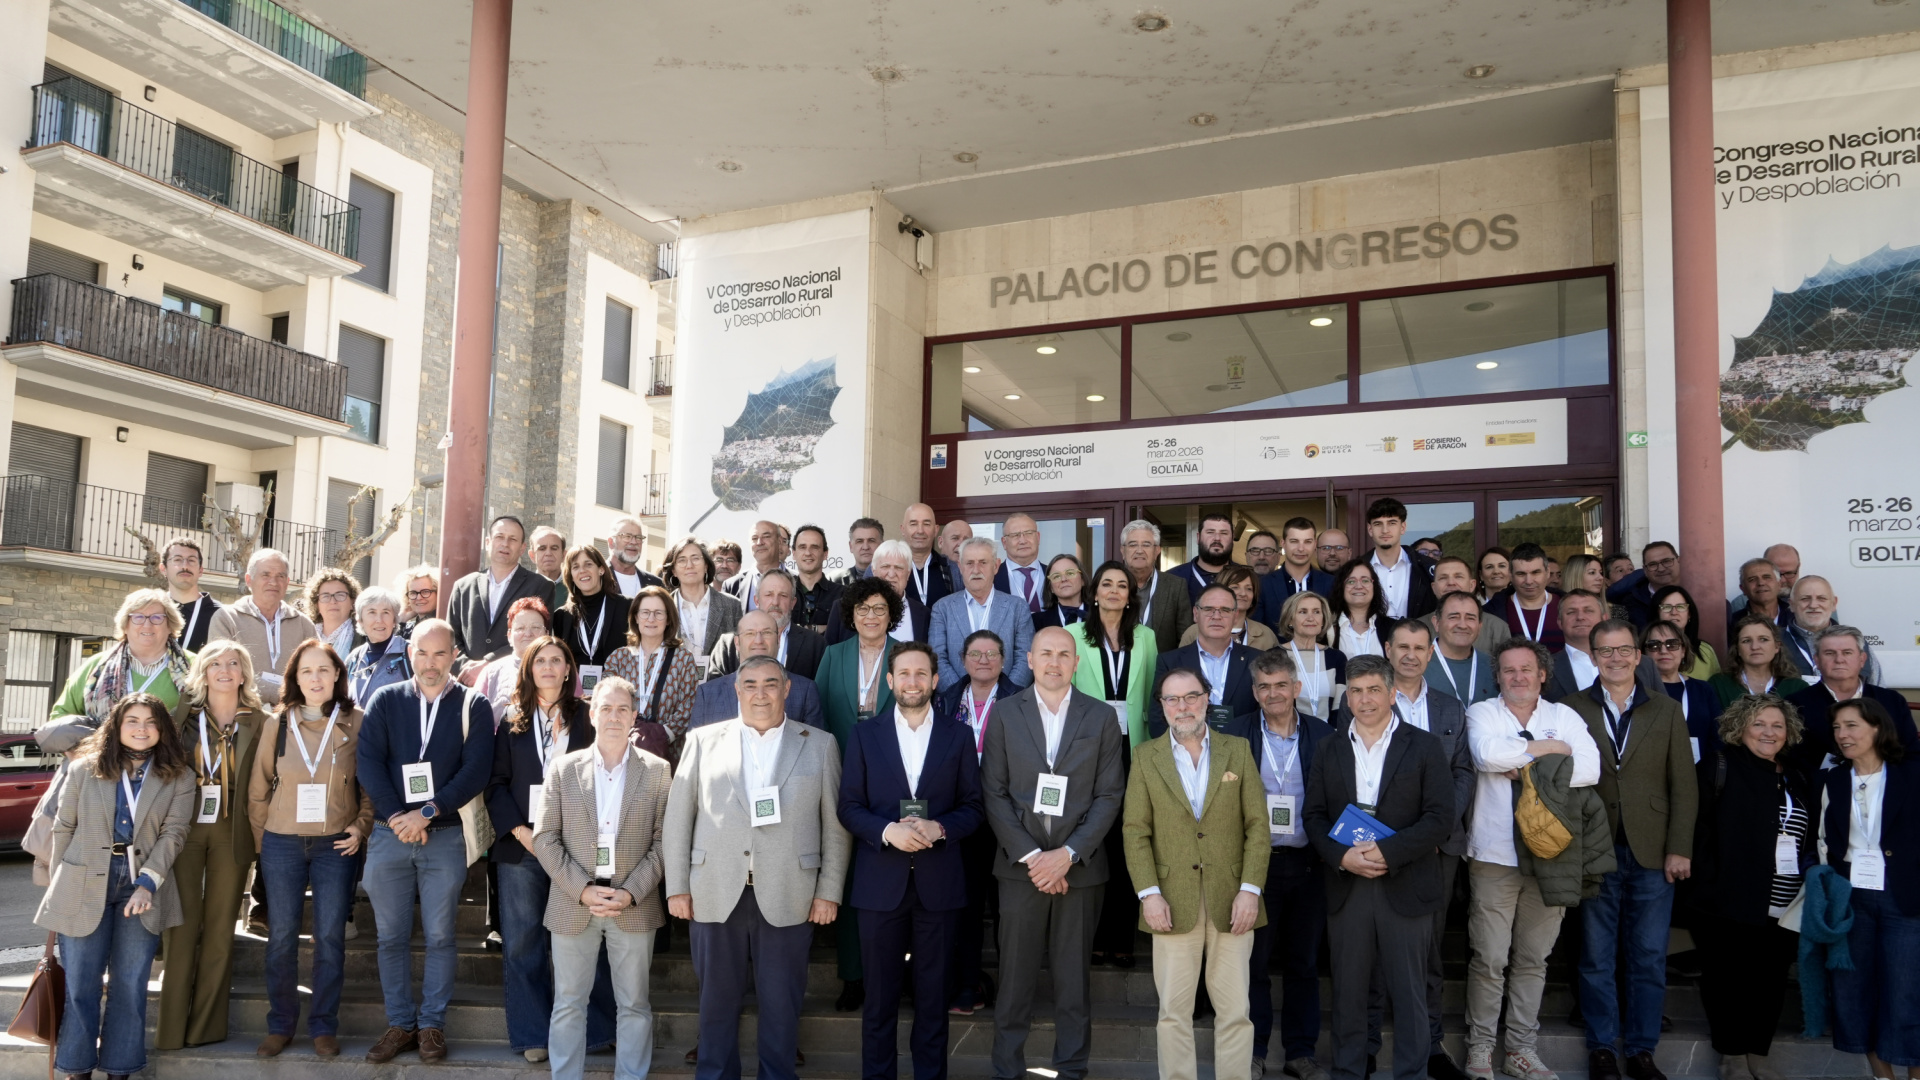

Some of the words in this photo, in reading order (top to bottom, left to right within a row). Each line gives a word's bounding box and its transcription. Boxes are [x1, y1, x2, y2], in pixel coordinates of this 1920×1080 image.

[1713, 139, 1824, 163] Congreso
[1829, 126, 1920, 151] Nacion
[1713, 167, 1731, 185] e
[1736, 153, 1856, 182] Desarrollo
[1721, 190, 1735, 209] y
[1739, 170, 1900, 203] Despoblación
[990, 259, 1151, 309] PALACIO
[1164, 250, 1218, 288] DE
[1231, 213, 1519, 280] CONGRESOS
[706, 285, 715, 299] V
[717, 279, 781, 297] Congreso
[782, 266, 841, 289] Nacional
[713, 300, 730, 314] de
[731, 291, 796, 311] Desarrollo
[798, 284, 833, 302] Rural
[724, 317, 732, 332] y
[733, 303, 821, 327] Despoblación
[984, 450, 992, 460] V
[993, 446, 1046, 461] Congreso
[1047, 443, 1095, 456] Nacional
[1147, 449, 1176, 458] marzo
[1177, 446, 1204, 457] 2026
[1425, 436, 1462, 445] GOBIERNO
[984, 461, 998, 472] de
[999, 458, 1052, 471] Desarrollo
[1054, 455, 1081, 467] Rural
[1151, 461, 1198, 475] BOLTAÑA
[984, 475, 991, 486] y
[991, 469, 1063, 484] Despoblación
[1848, 517, 1912, 532] marzo
